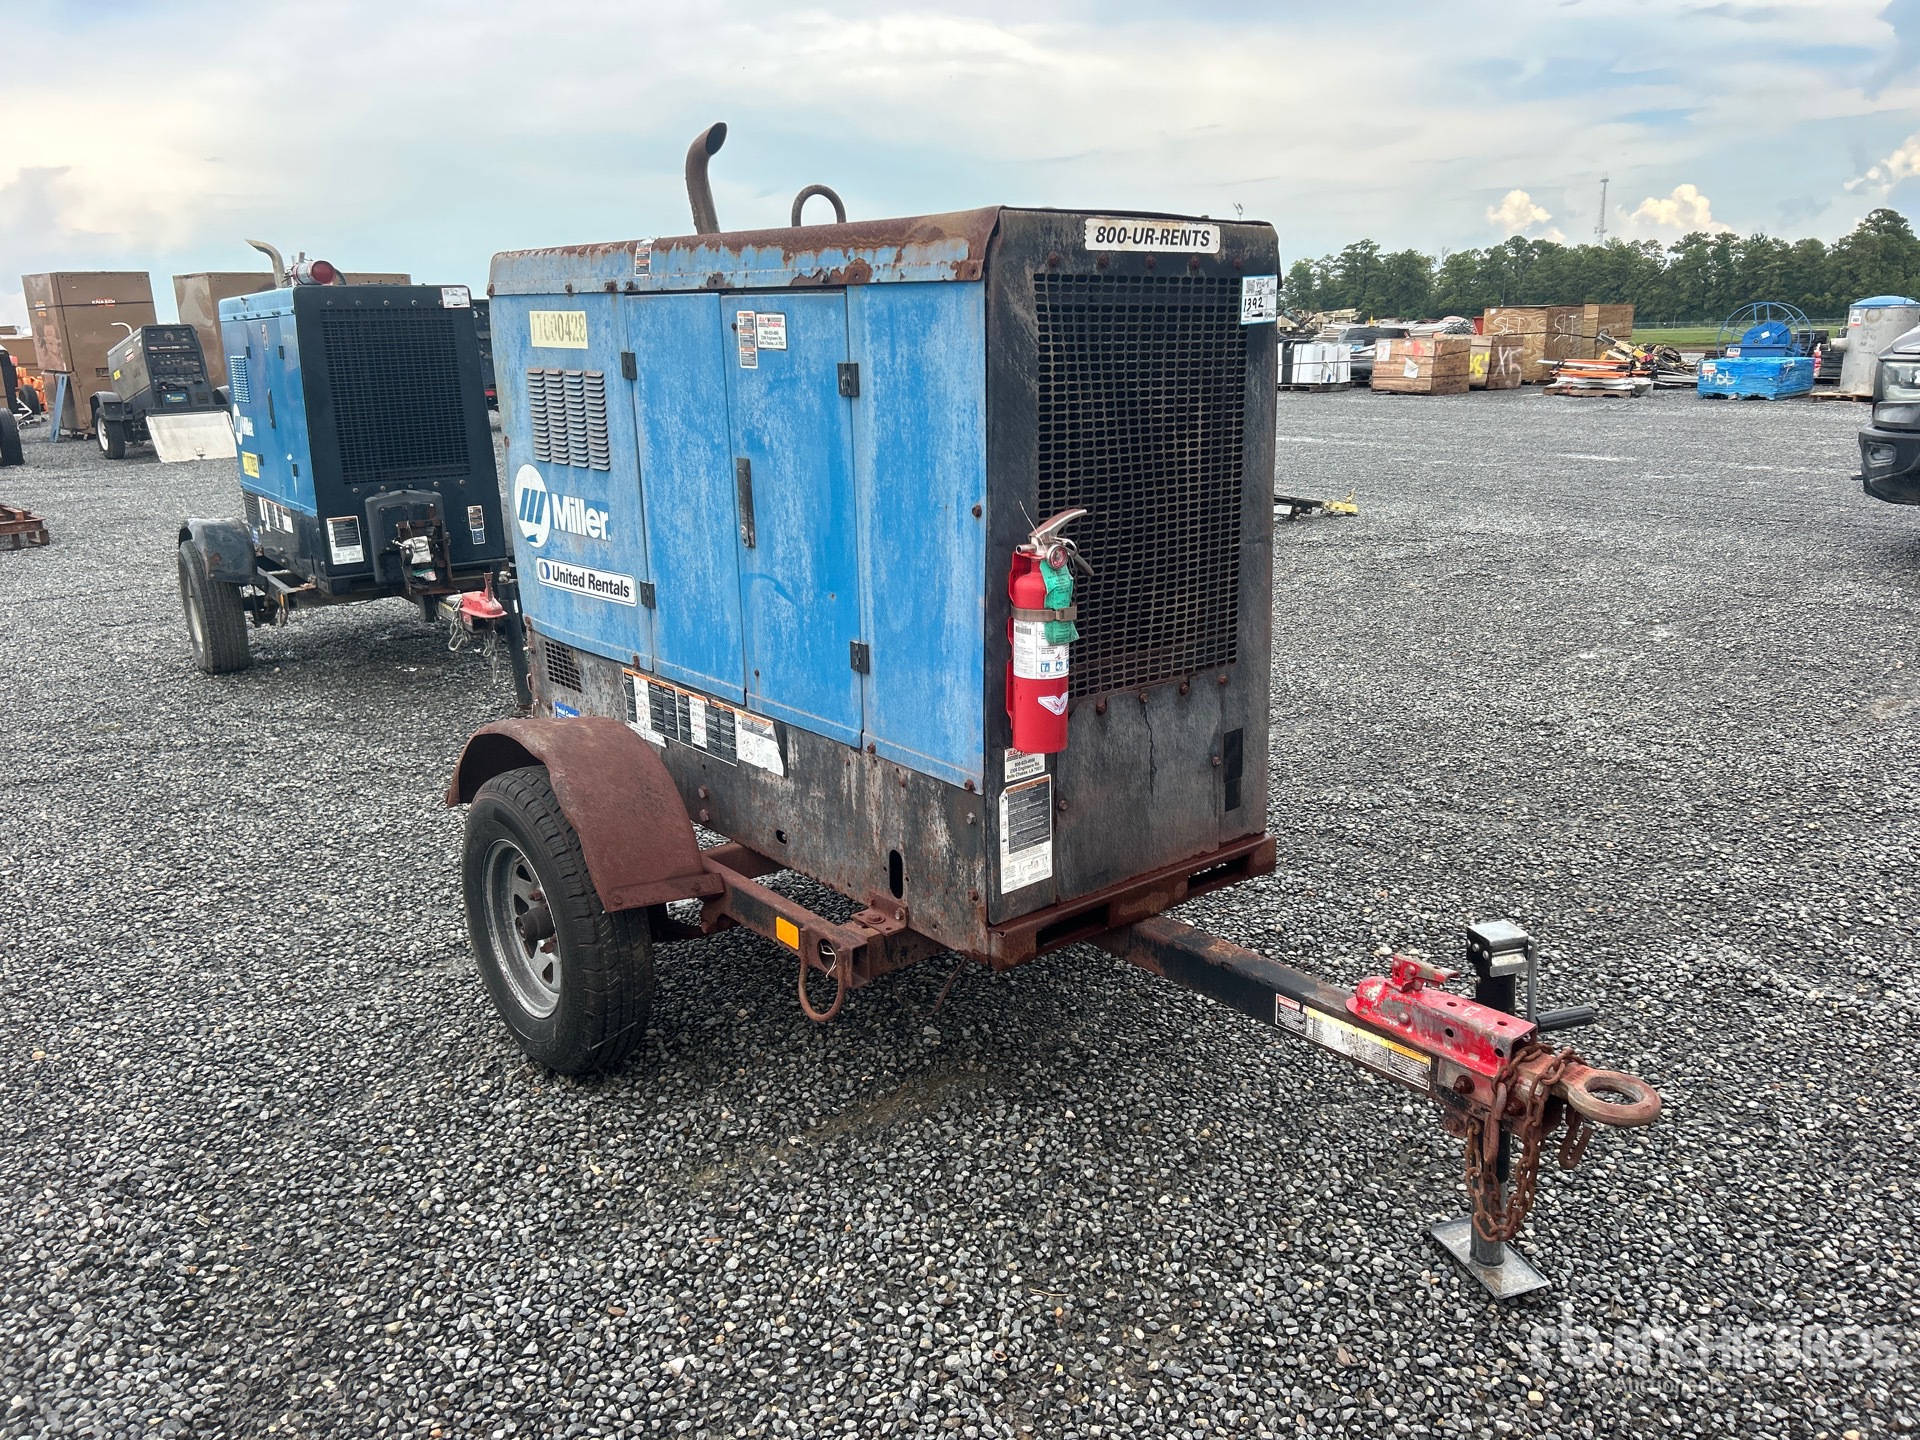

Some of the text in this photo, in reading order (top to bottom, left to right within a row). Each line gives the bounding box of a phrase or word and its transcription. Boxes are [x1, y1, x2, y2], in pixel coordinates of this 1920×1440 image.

[1095, 225, 1211, 247] 800-UR-RENTS
[1243, 296, 1264, 312] 1392
[551, 493, 610, 541] Miller
[552, 564, 630, 598] United Rentals
